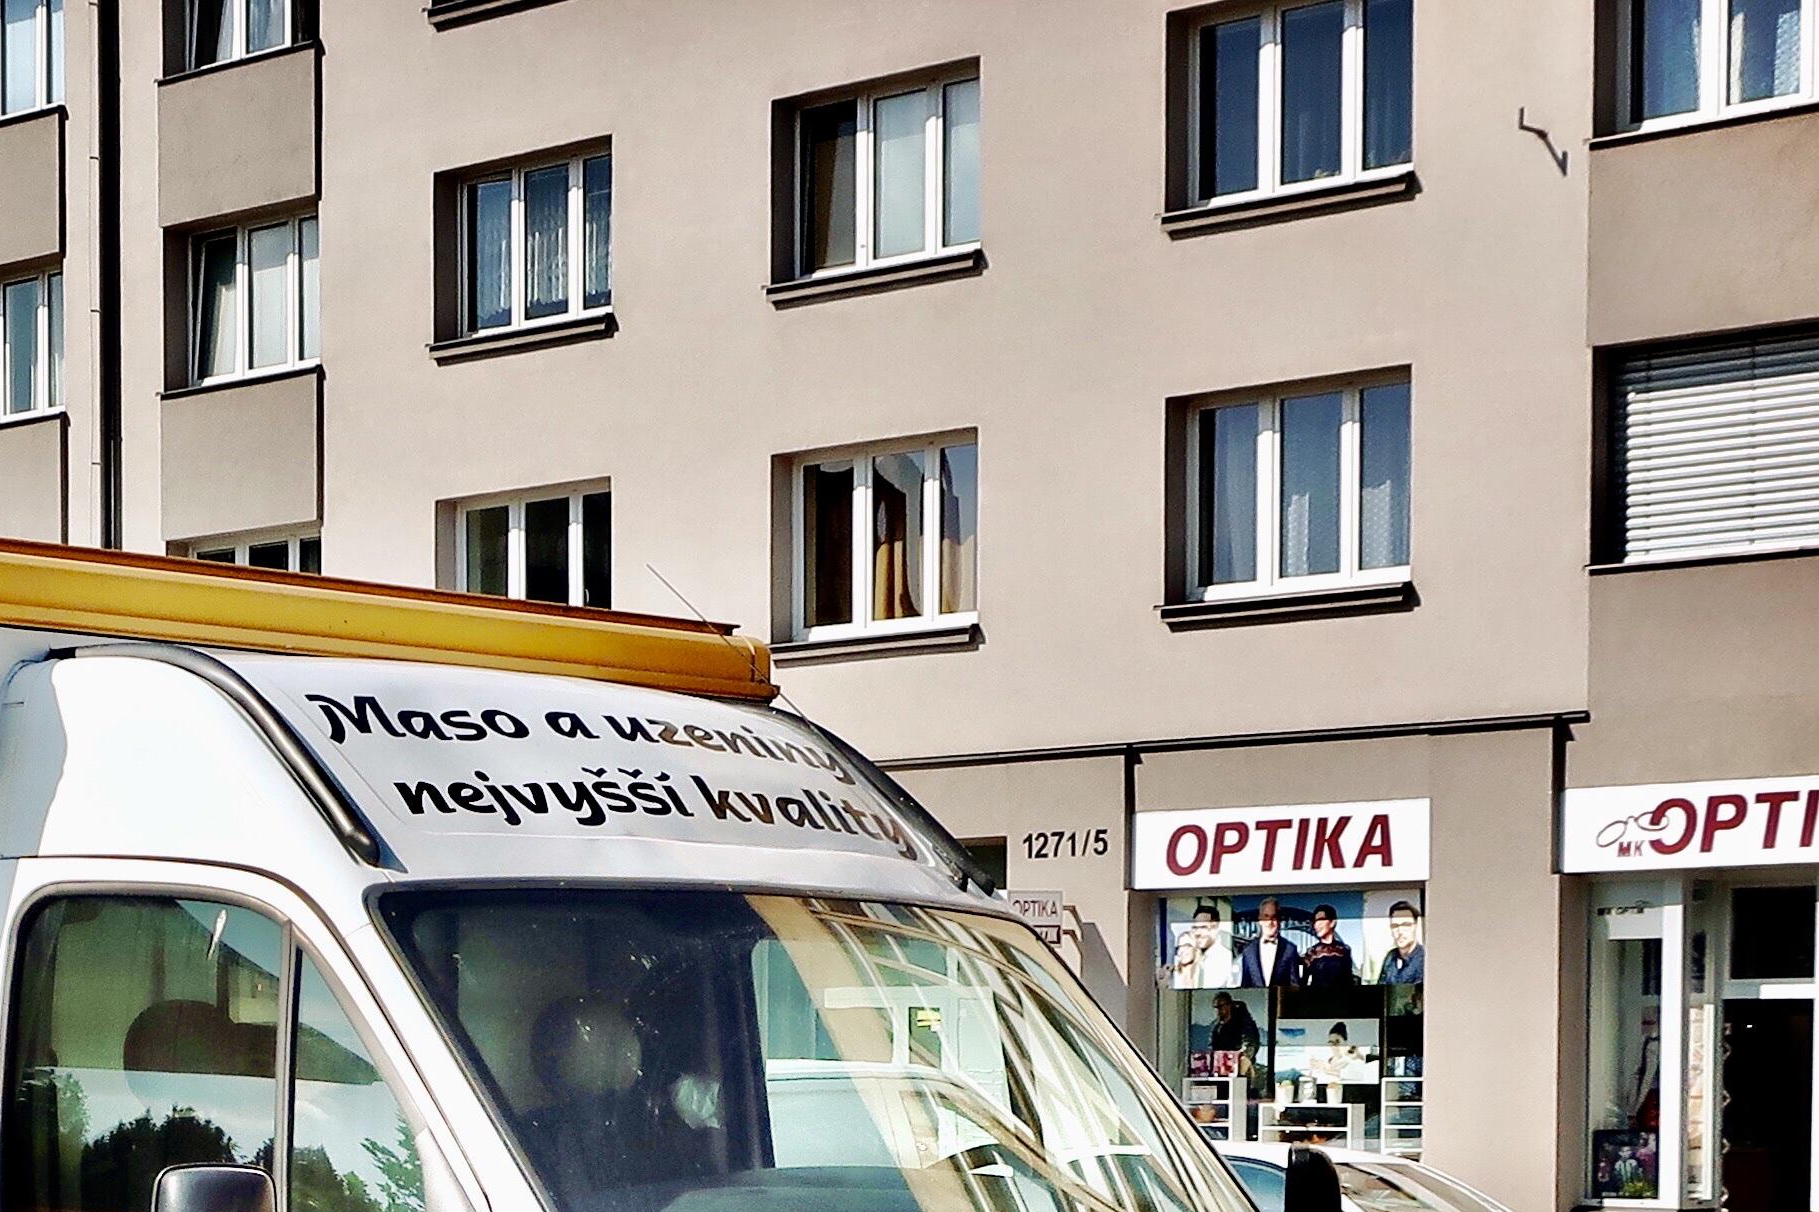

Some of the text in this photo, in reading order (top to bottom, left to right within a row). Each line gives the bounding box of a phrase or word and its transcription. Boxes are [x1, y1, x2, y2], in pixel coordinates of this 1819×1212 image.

[304, 693, 857, 786] Maso a uzeniny
[393, 766, 918, 861] nejvyšší kvality
[1022, 828, 1109, 859] 1271/5
[1165, 813, 1395, 877] OPTIKA
[1616, 840, 1646, 857] MK
